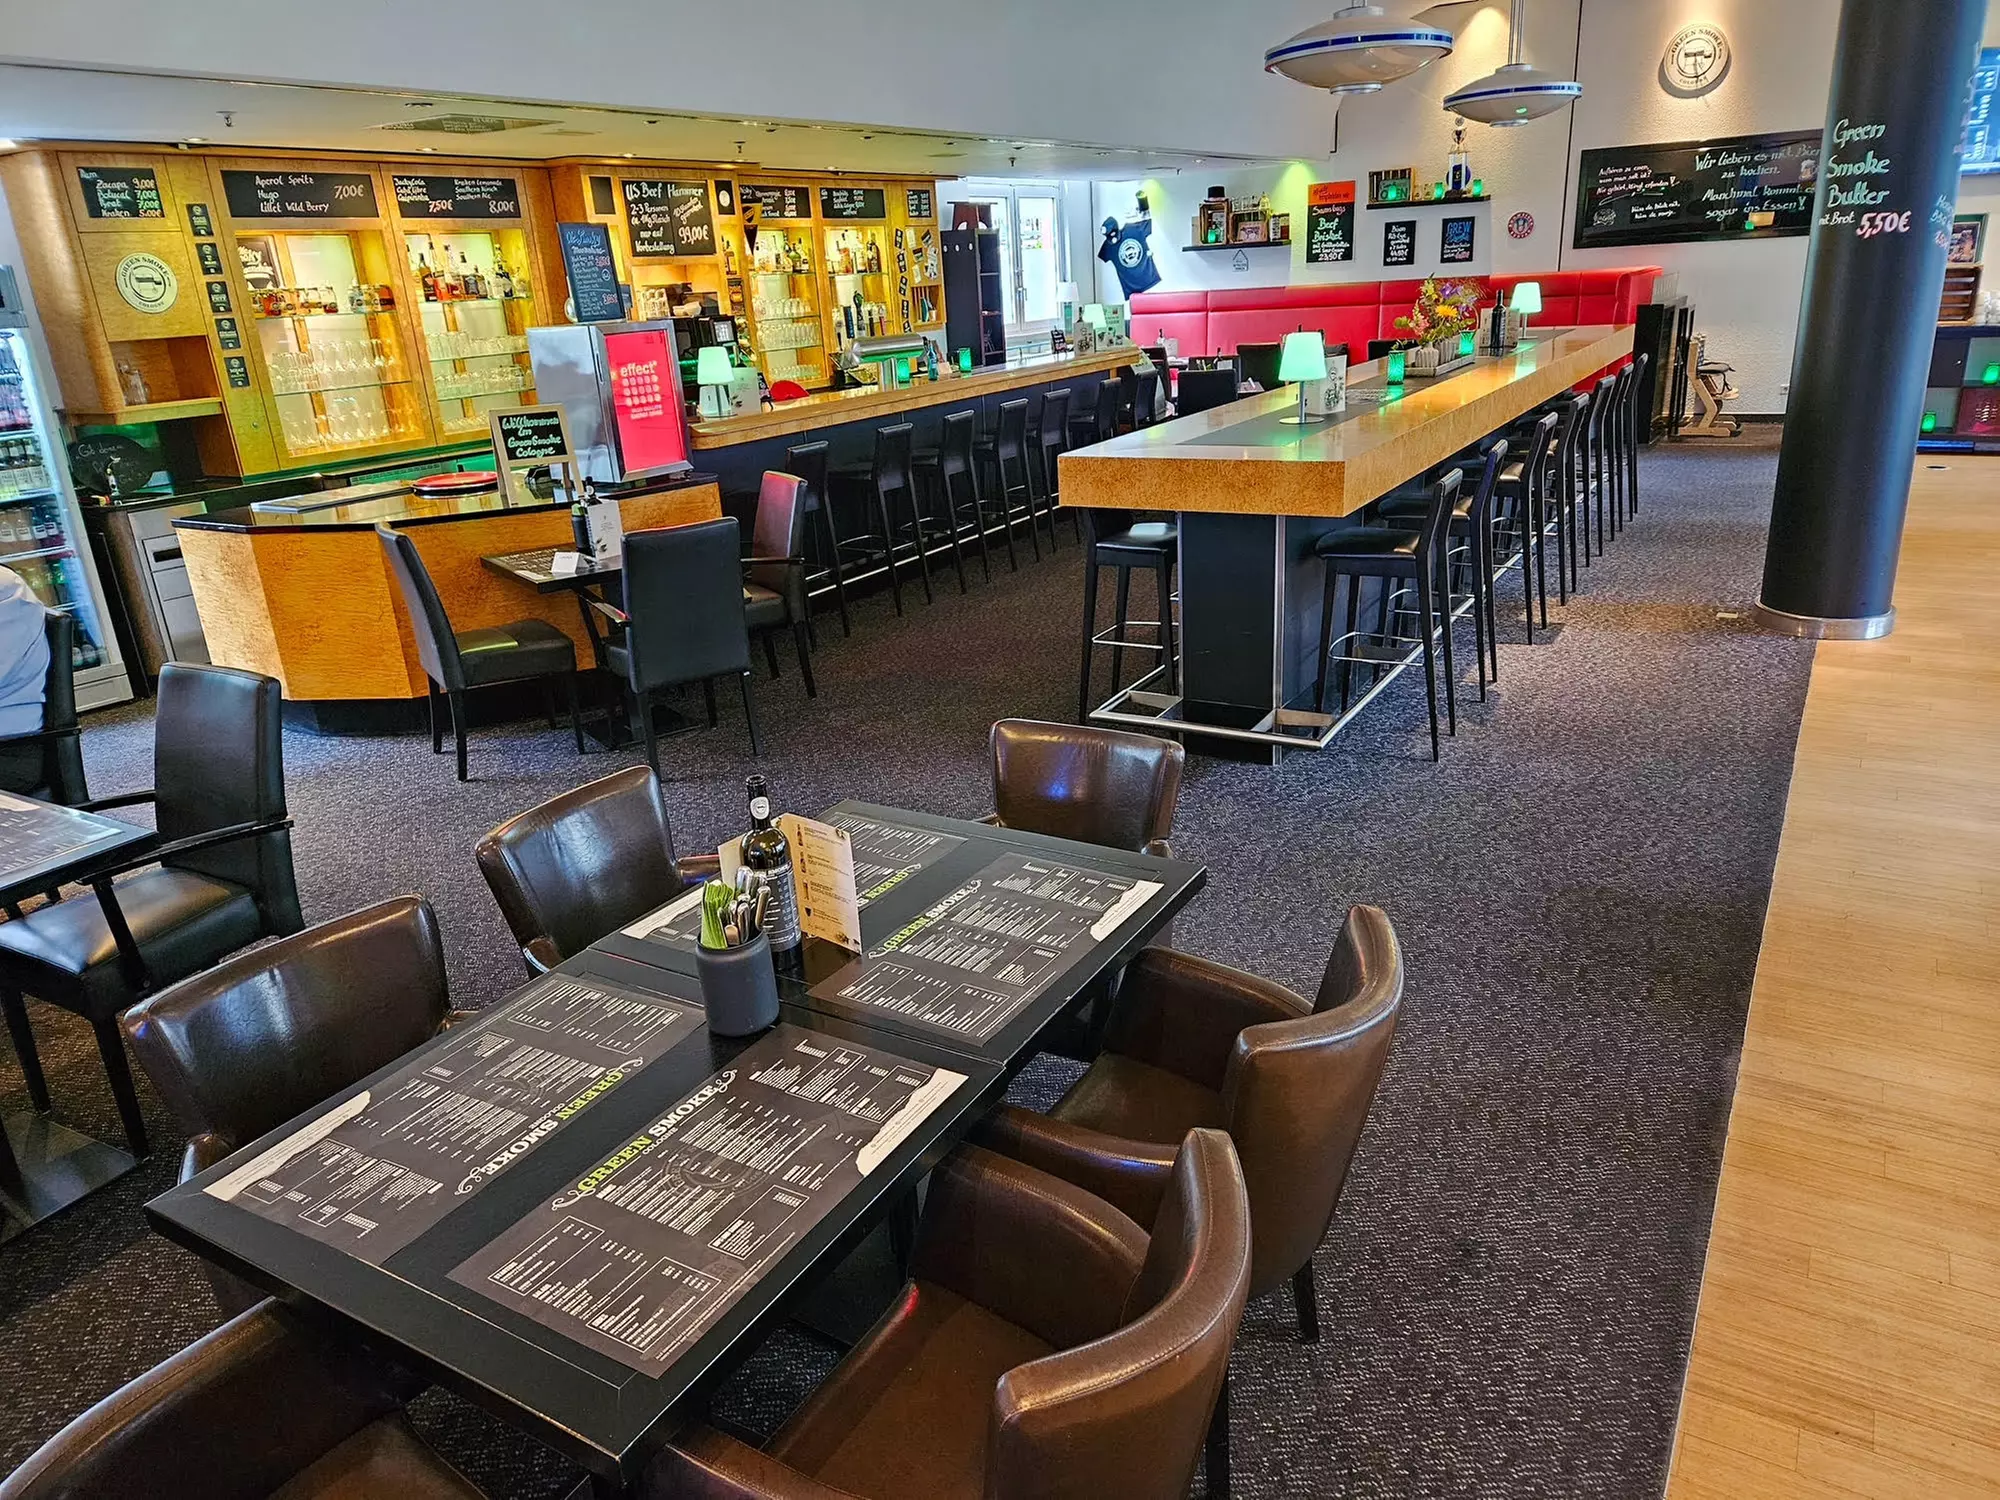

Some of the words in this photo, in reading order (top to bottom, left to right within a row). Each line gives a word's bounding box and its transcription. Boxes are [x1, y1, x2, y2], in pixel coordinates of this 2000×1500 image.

[1671, 30, 1697, 53] GREEN
[1699, 29, 1724, 48] SMOKE
[1833, 118, 1886, 149] Green
[1695, 152, 1716, 171] Wir
[1718, 151, 1751, 166] lieben
[1754, 152, 1767, 161] es
[1826, 150, 1891, 179] Smoke
[96, 179, 129, 190] Zacapa
[255, 175, 283, 187] Aperol
[288, 175, 314, 187] Spritz
[1721, 171, 1736, 179] zu
[257, 190, 280, 204] Hugo
[333, 184, 365, 200] 7,00€
[625, 183, 640, 201] US
[640, 182, 662, 198] Beef
[667, 184, 704, 198] Hammer
[1381, 187, 1408, 200] OEN
[1702, 186, 1759, 202] Manchmal
[1763, 184, 1801, 196] kommt
[1827, 181, 1891, 208] Butter
[260, 201, 282, 213] Lillet
[285, 202, 304, 212] Wild
[306, 202, 330, 213] Berry
[428, 199, 455, 213] 7,50€
[489, 200, 516, 214] 8,00€
[644, 202, 669, 213] Personen
[1705, 207, 1738, 222] sogar
[1743, 201, 1760, 213] ins
[652, 226, 664, 238] auf
[1317, 218, 1339, 230] Beef
[1447, 221, 1472, 234] CREW
[1830, 211, 1856, 226] Brot
[1856, 211, 1912, 239] 5,50€
[678, 224, 710, 245] 99,00€
[1312, 230, 1343, 242] Brisket
[635, 240, 675, 255] Vorbestellung
[121, 257, 141, 278] GREEN
[142, 256, 168, 275] SMOKE
[502, 416, 559, 430] Willkommen
[516, 447, 556, 459] Cologne
[884, 916, 929, 949] GREEN
[925, 888, 971, 918] SMOKE
[555, 1071, 624, 1121] GREEN
[528, 1102, 565, 1129] COLOGNE
[481, 1119, 559, 1175] SMOKE
[577, 1135, 652, 1192] GREEN
[648, 1085, 719, 1138] SMOKE
[642, 1126, 678, 1155] COLOGNE
